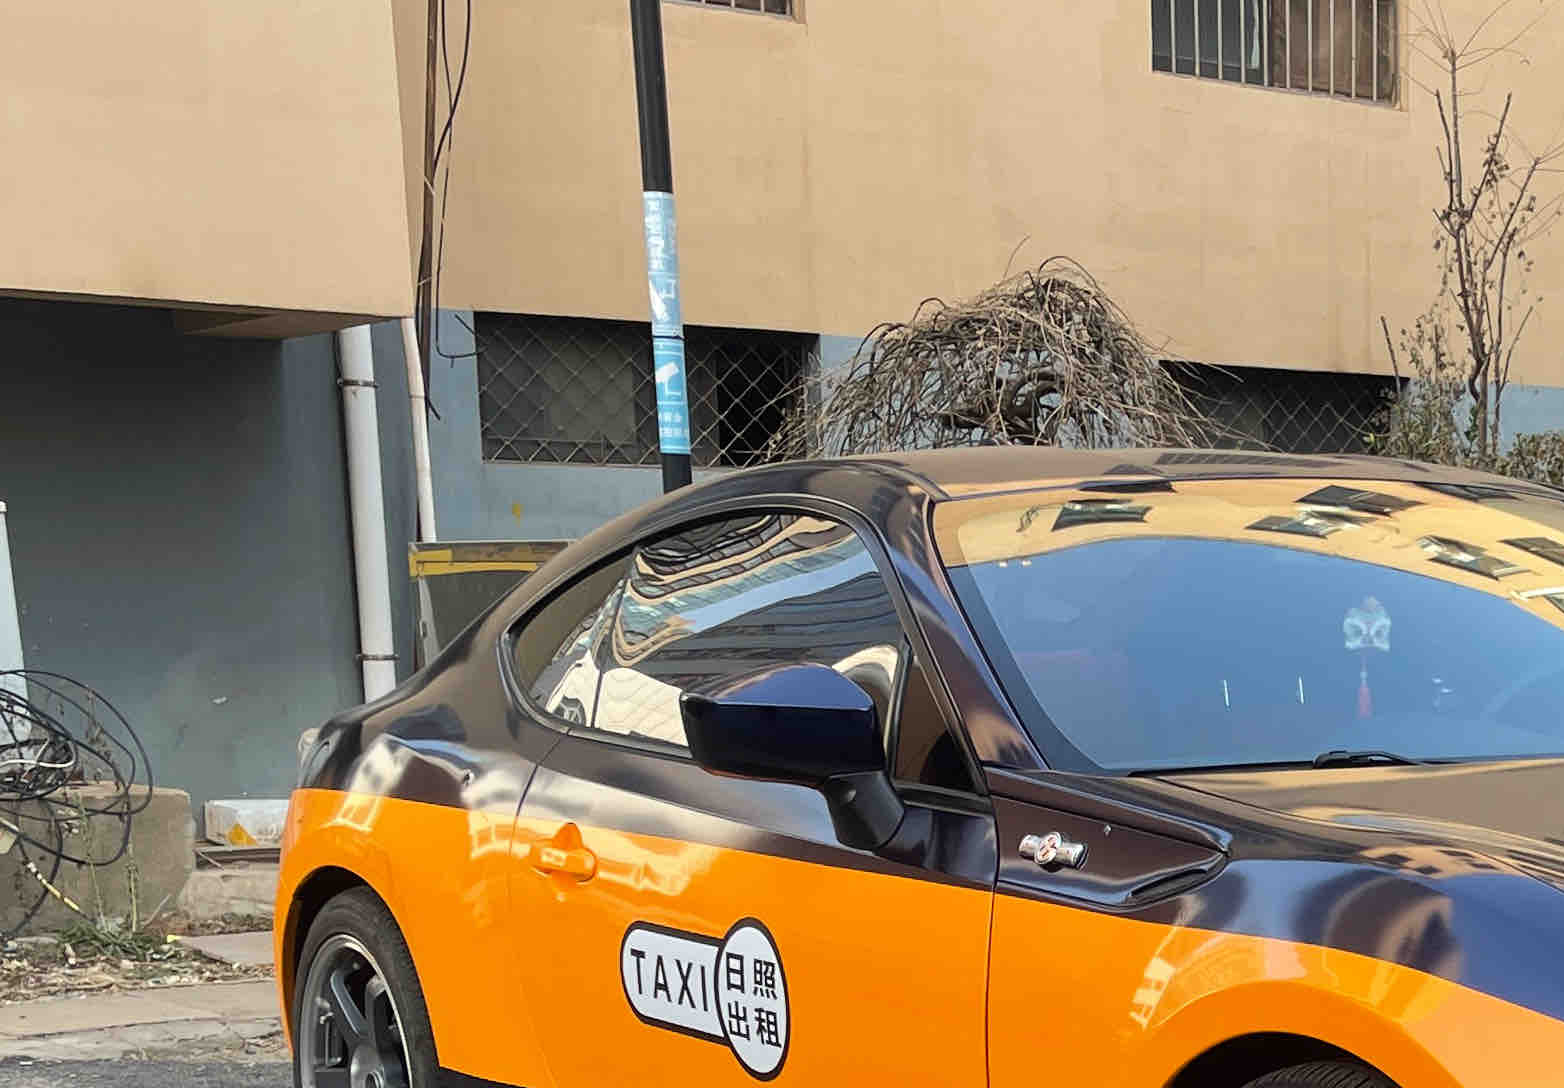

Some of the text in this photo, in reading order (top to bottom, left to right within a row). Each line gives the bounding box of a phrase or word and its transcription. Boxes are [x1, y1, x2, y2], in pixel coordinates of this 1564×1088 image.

[630, 949, 708, 1012] TAXI
[726, 952, 777, 1000] 日照
[728, 1001, 782, 1048] 出租
